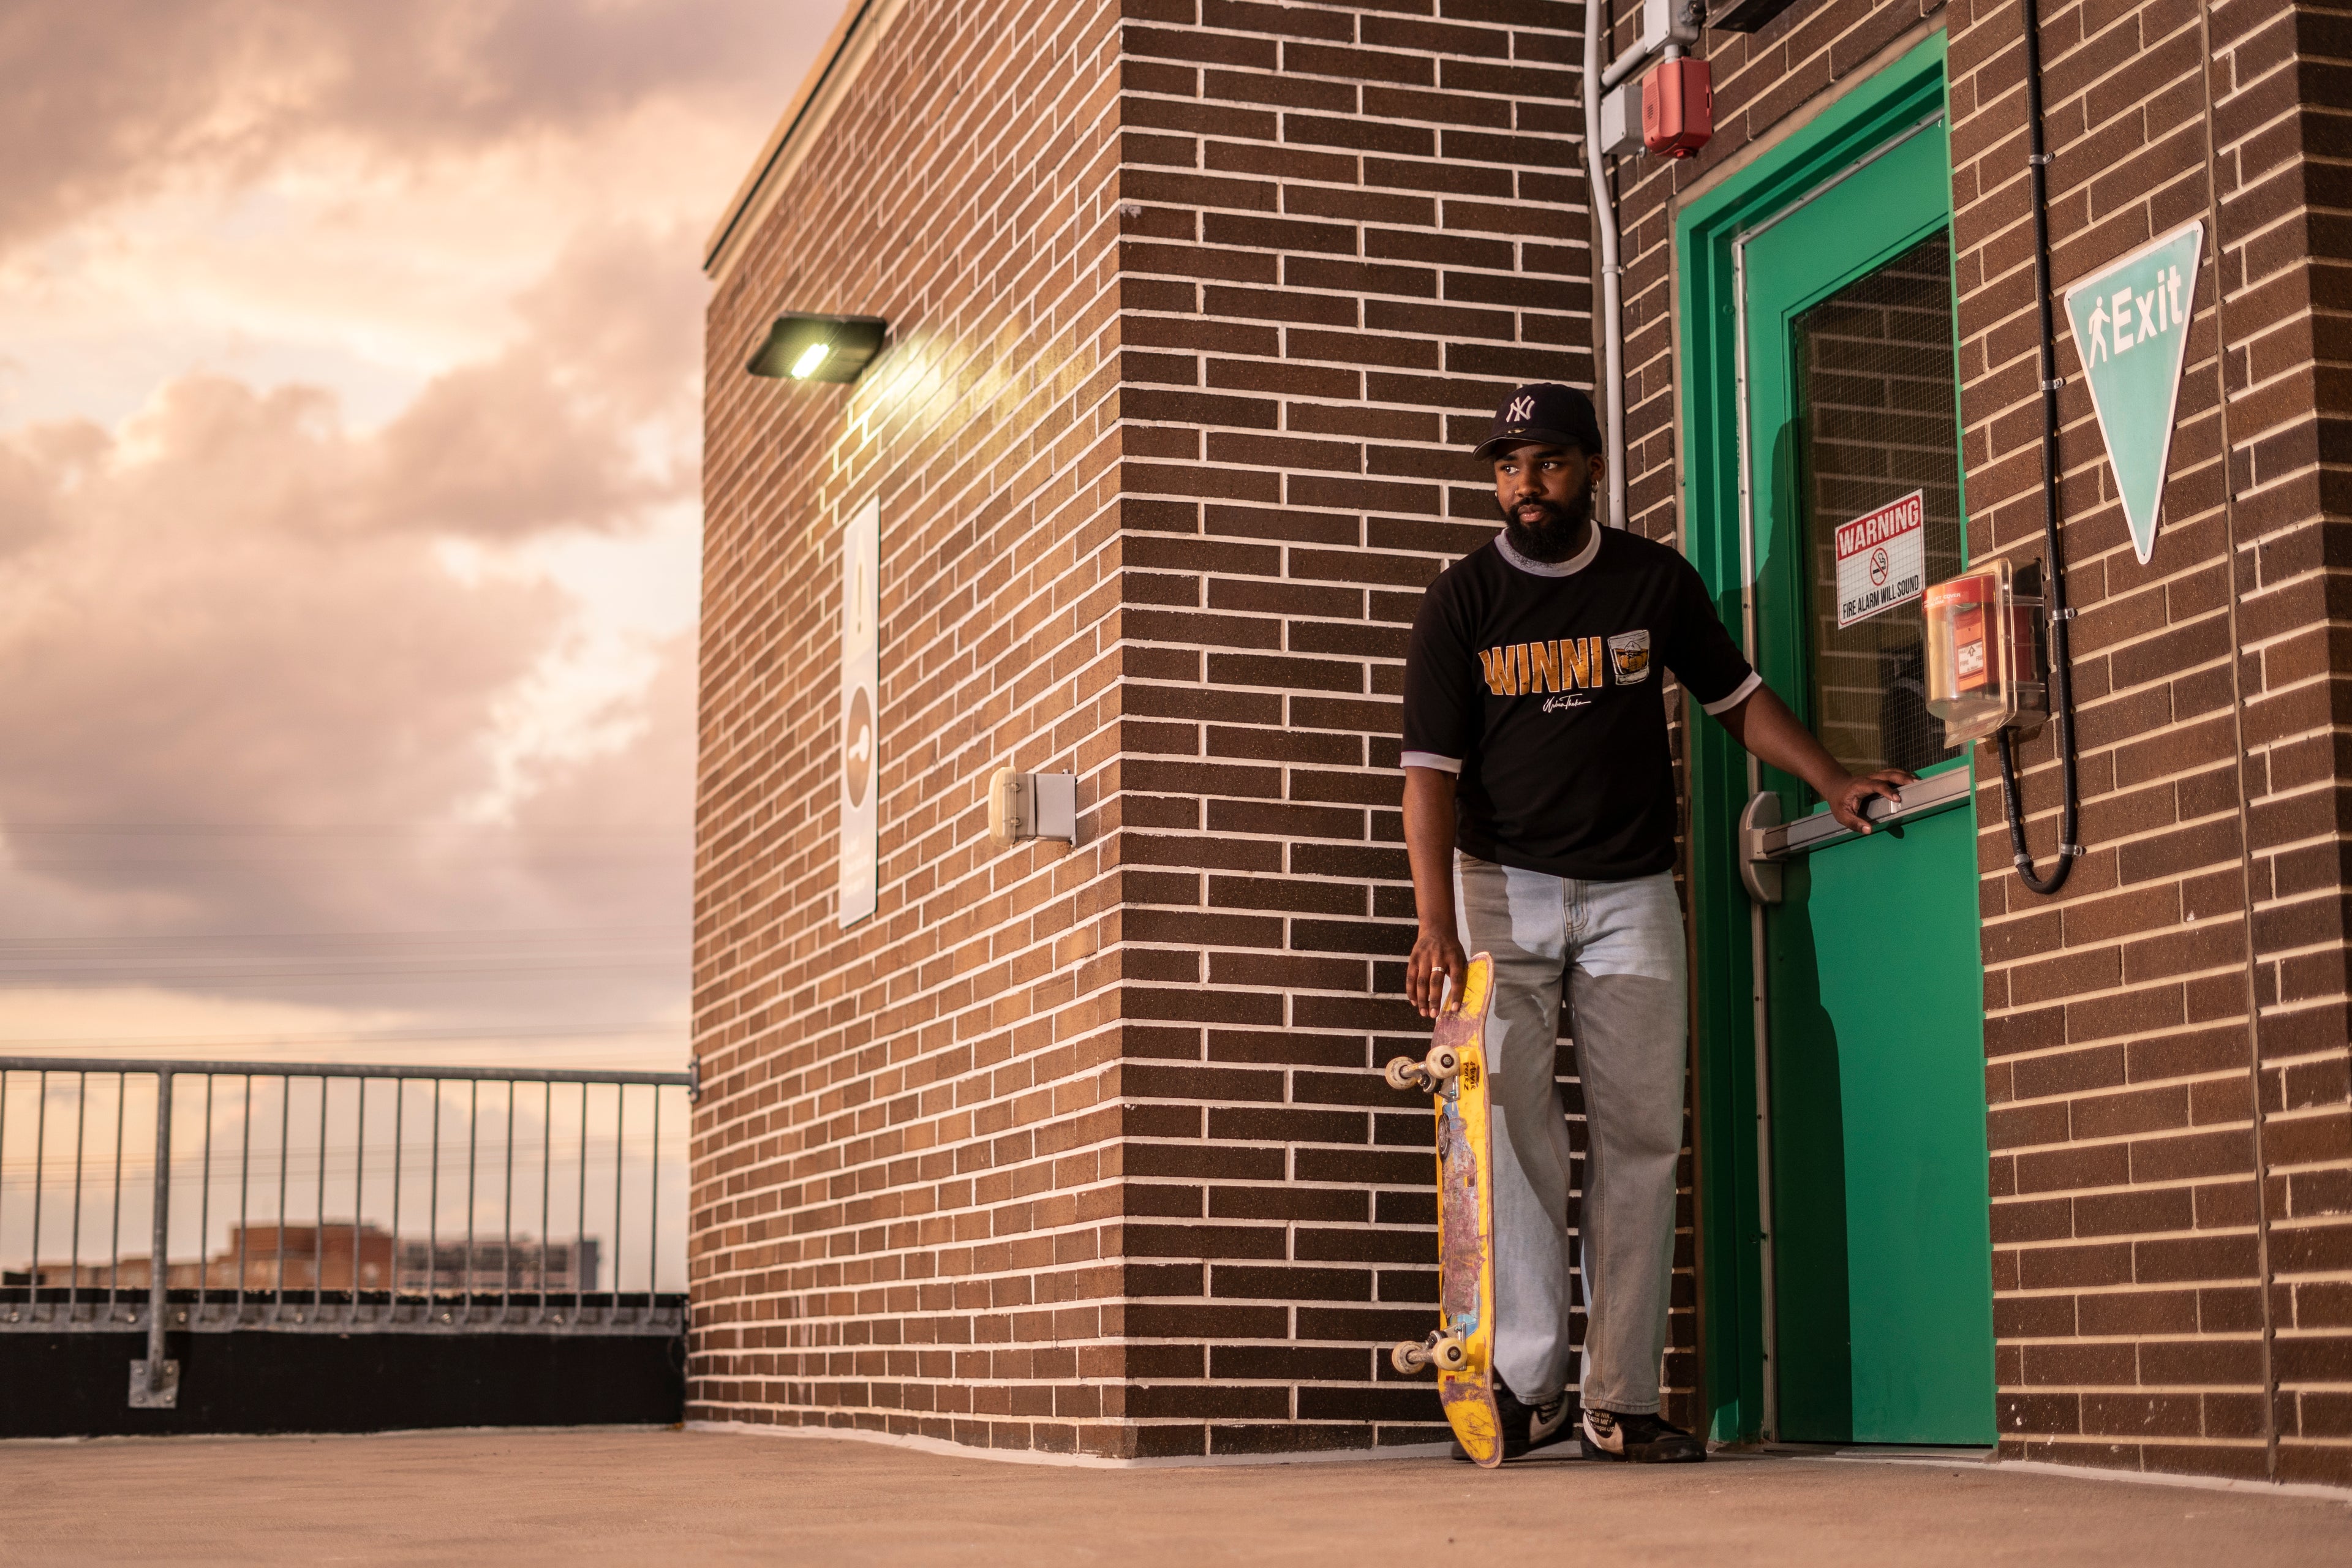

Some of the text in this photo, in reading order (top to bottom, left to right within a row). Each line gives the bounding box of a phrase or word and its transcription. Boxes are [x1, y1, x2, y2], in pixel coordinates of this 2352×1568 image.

[2112, 265, 2182, 355] Exit
[1506, 395, 1536, 423] NY
[1839, 499, 1919, 557] WARNING
[1843, 575, 1919, 619] FIRE ALARM WILL SOUND
[1478, 636, 1602, 695] WINNI
